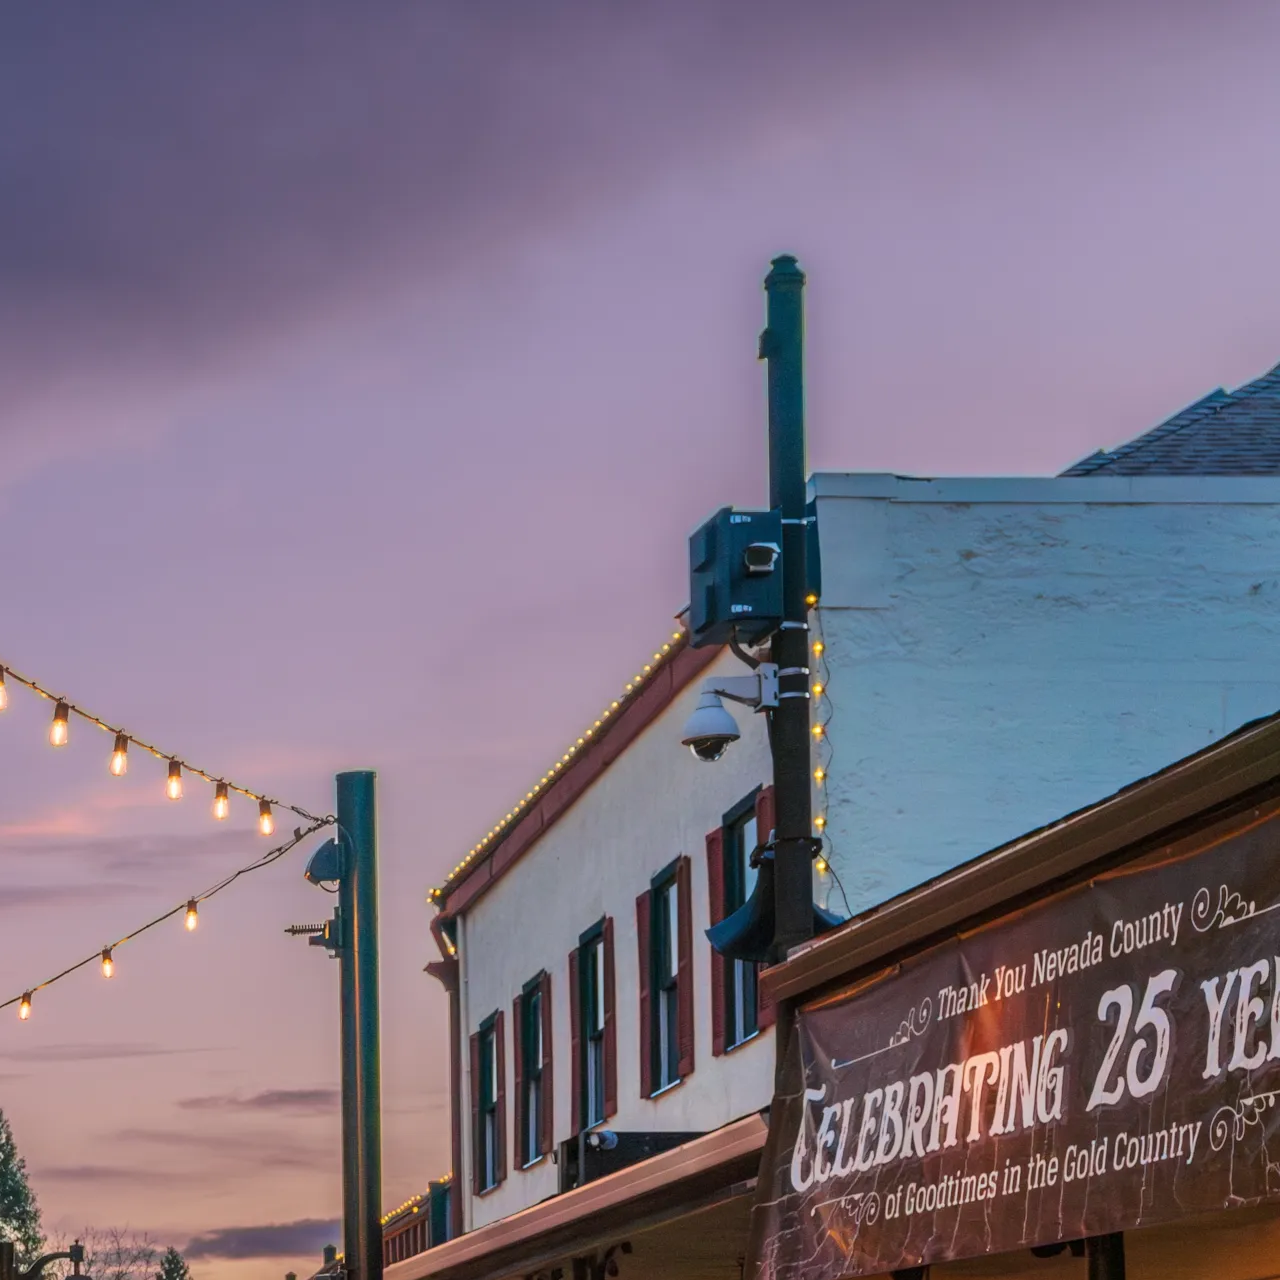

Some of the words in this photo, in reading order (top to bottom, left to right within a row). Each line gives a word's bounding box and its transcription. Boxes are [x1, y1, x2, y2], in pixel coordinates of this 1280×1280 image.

[936, 973, 990, 1022] Thank
[993, 963, 1027, 1003] You
[1031, 931, 1104, 986] Nevada
[1109, 901, 1184, 959] County
[790, 1027, 1069, 1193] CELEBRATING
[1086, 969, 1178, 1112] 25
[884, 1181, 902, 1221] of
[904, 1169, 999, 1217] Goodtimes
[1002, 1158, 1022, 1196] in
[1026, 1153, 1058, 1192] the
[1063, 1136, 1109, 1183] Gold
[1112, 1120, 1203, 1172] Country
